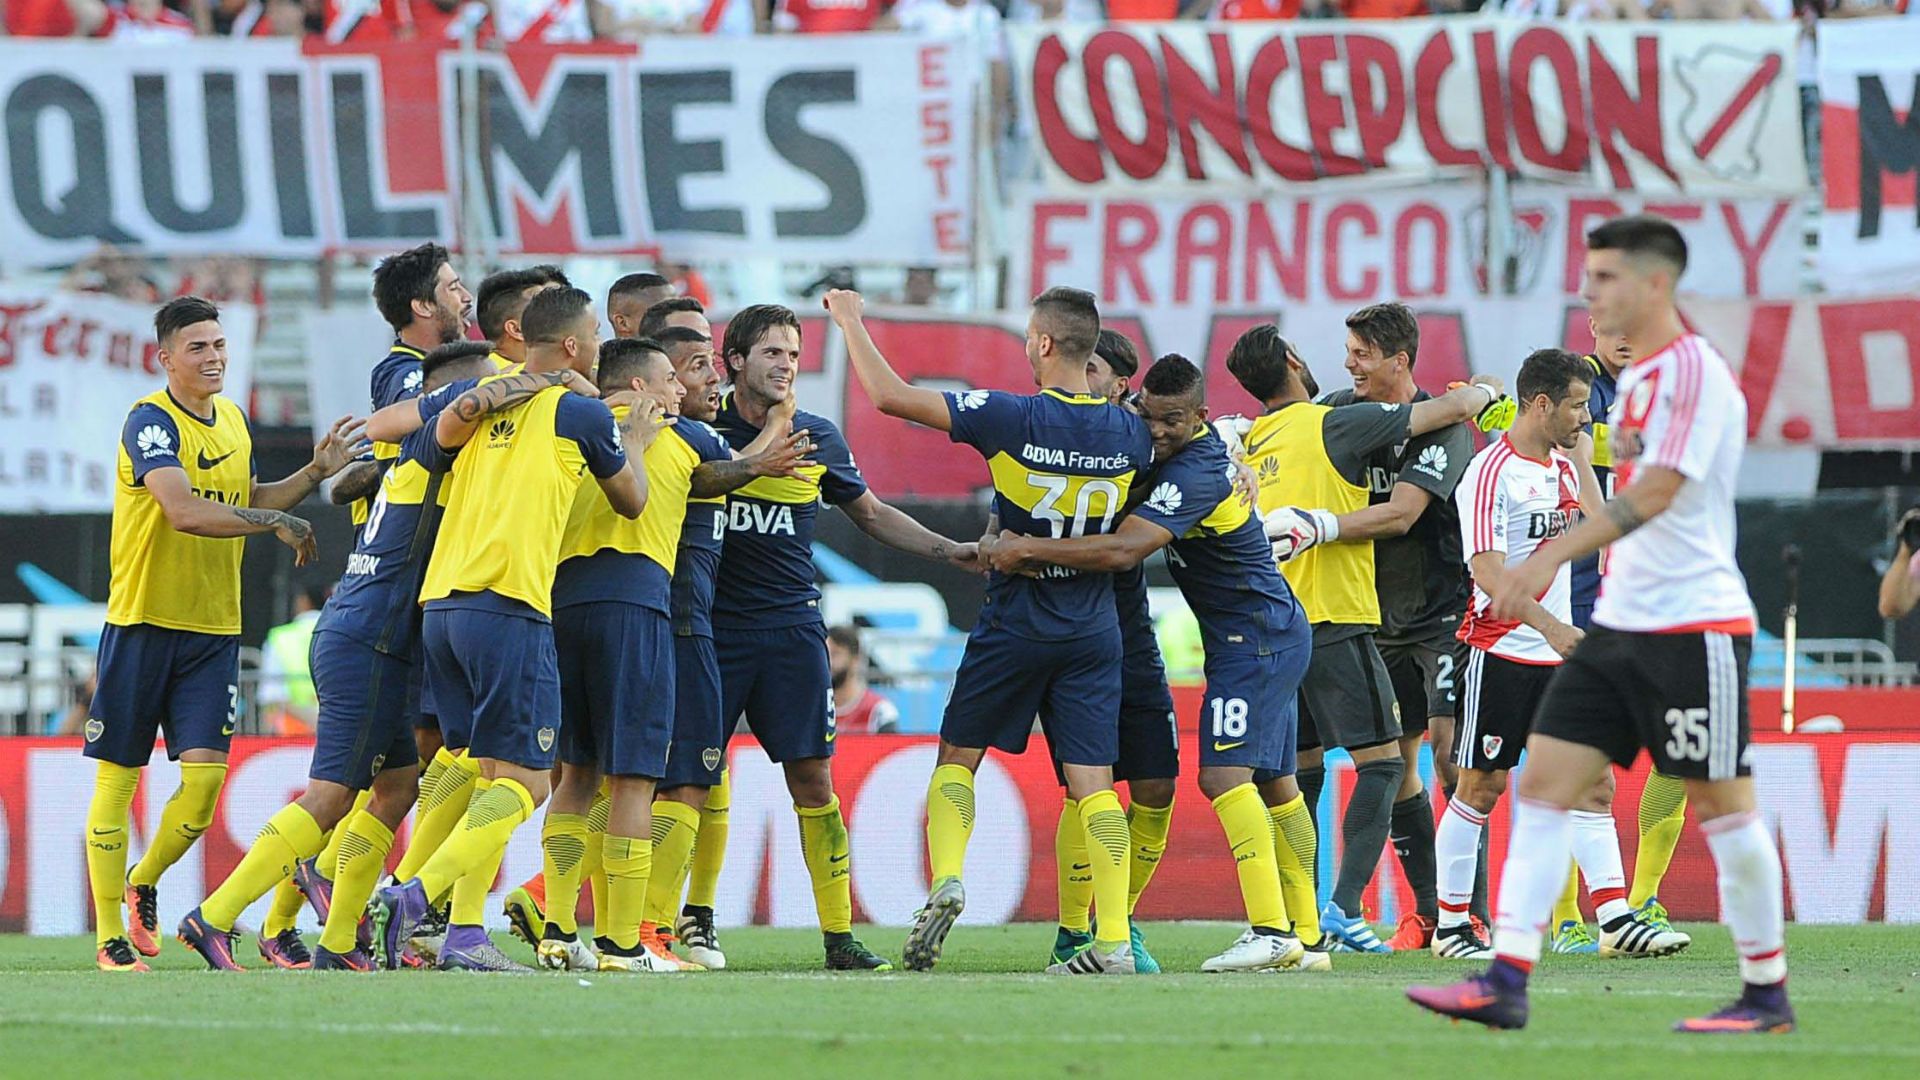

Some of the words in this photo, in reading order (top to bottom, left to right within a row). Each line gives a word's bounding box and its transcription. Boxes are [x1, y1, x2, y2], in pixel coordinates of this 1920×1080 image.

[917, 46, 966, 253] ESTE
[1033, 27, 1684, 190] CONCEPCION
[3, 69, 867, 244] QUILMES
[1030, 202, 1447, 303] FRANCO
[1565, 200, 1792, 296] RY
[1022, 443, 1066, 467] BBVA
[1068, 452, 1129, 470] Francés
[723, 501, 796, 535] BVA
[1026, 472, 1119, 540] 30
[1210, 697, 1249, 738] 18
[1664, 707, 1709, 762] 35
